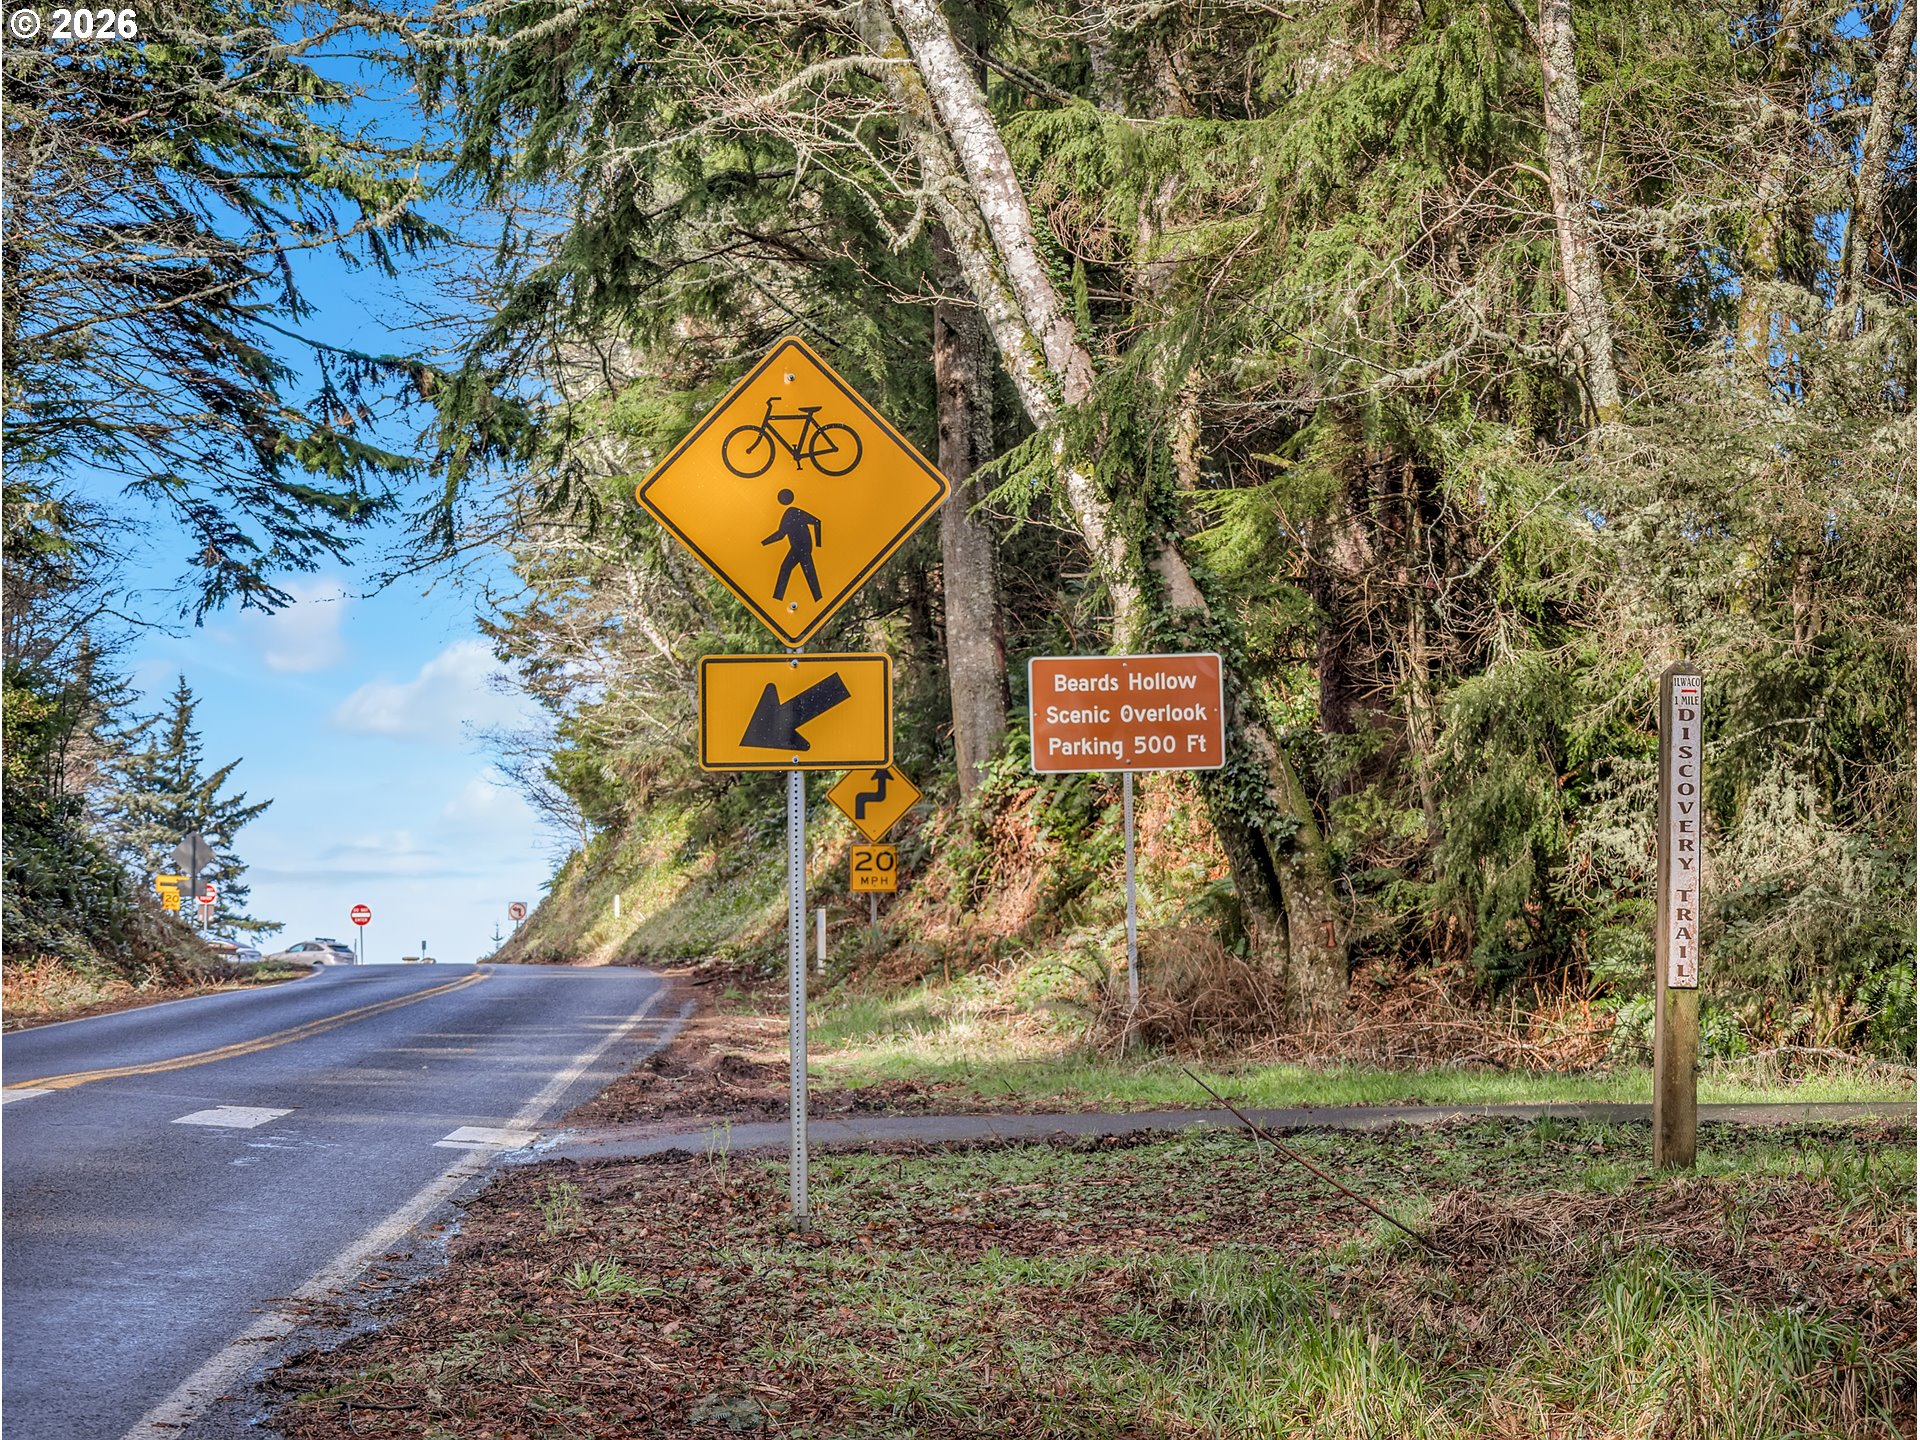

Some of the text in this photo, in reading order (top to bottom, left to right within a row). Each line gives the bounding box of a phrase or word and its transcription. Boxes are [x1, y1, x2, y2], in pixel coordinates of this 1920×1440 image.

[1054, 672, 1197, 692] Beards Hollow
[1673, 677, 1700, 687] ILWACO
[1681, 696, 1700, 706] MILE
[1046, 703, 1207, 724] Scenic Overlook
[1048, 735, 1207, 760] Parking 500 Ft
[1675, 708, 1695, 978] DISCOVERY TRAIL
[855, 851, 894, 871] 20
[860, 876, 889, 885] MPH
[165, 894, 180, 903] 20
